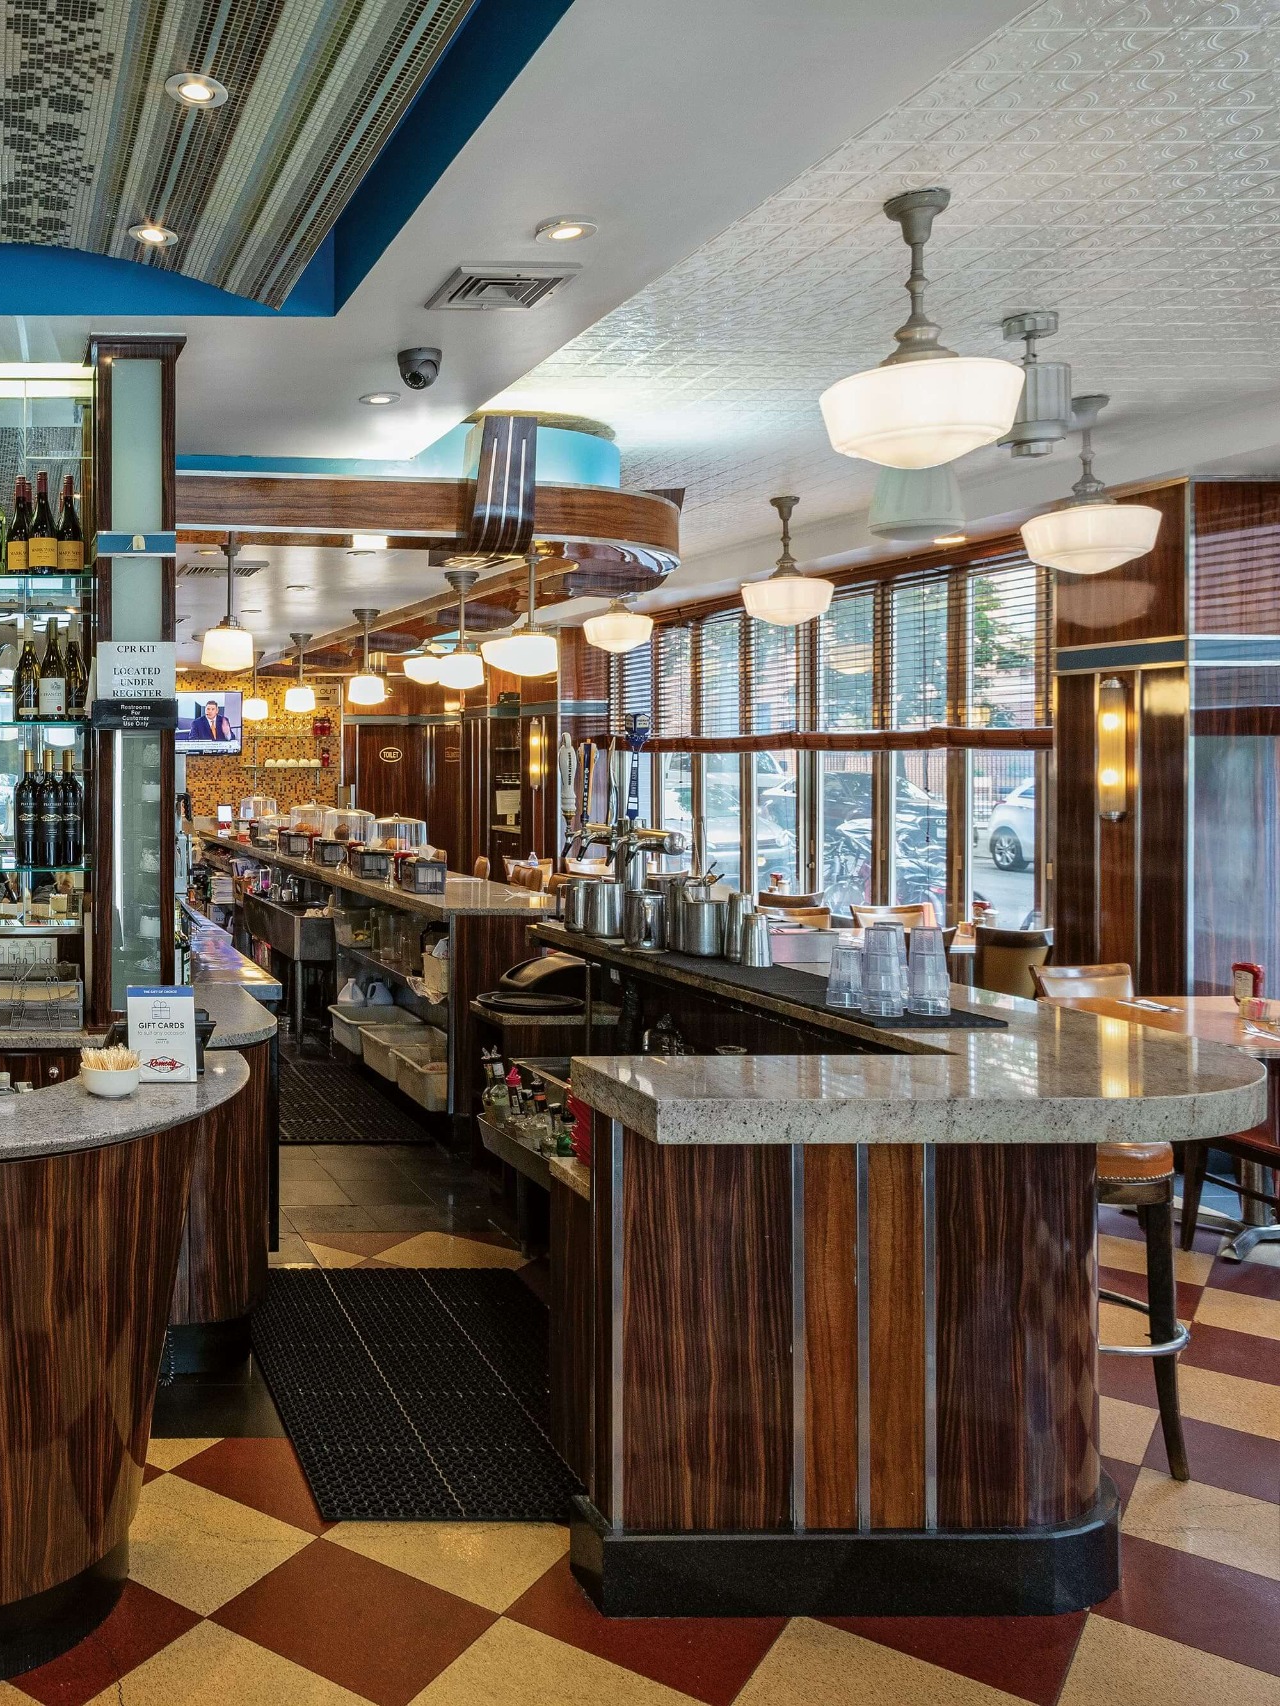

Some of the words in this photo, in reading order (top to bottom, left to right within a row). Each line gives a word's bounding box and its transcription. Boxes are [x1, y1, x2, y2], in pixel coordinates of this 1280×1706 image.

[116, 645, 136, 653] CPR
[139, 645, 157, 653] KIT
[113, 667, 161, 675] LOCATED
[120, 678, 154, 686] UNDER
[112, 689, 162, 697] REGISTER
[150, 1058, 177, 1070] Remedy
